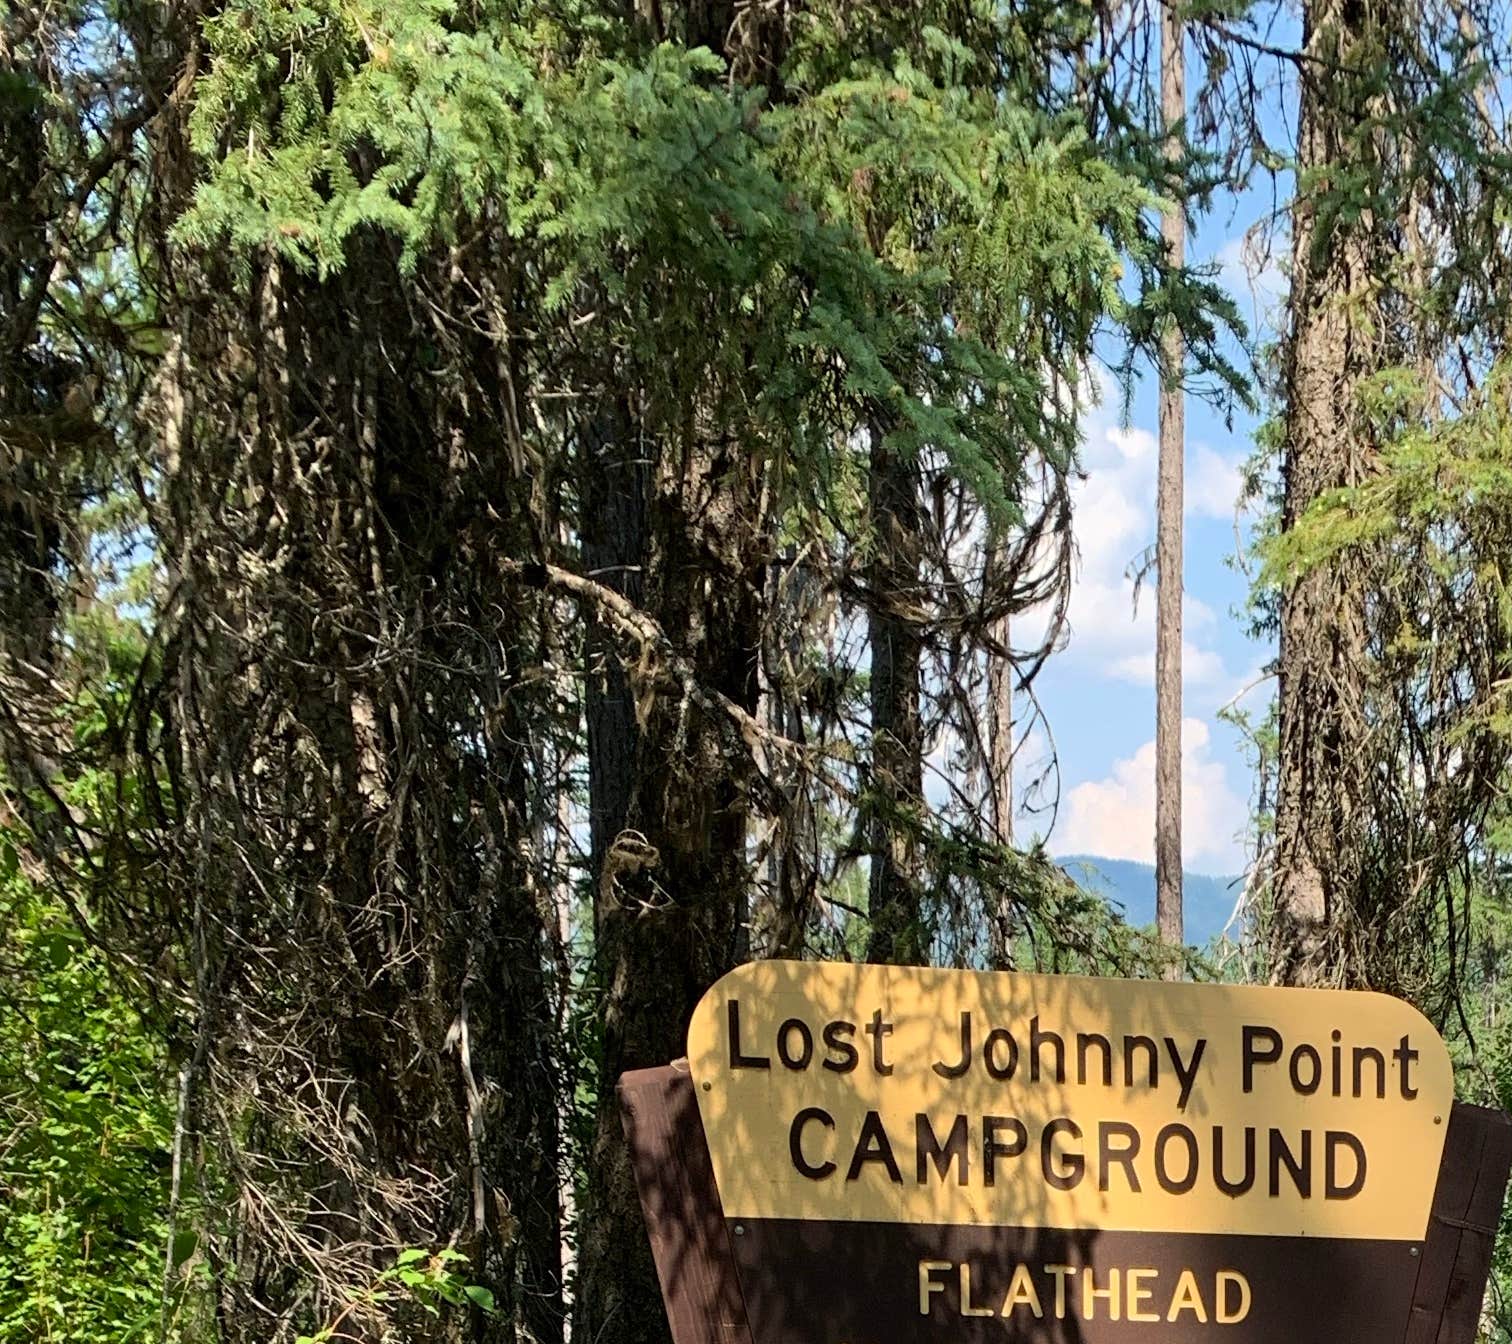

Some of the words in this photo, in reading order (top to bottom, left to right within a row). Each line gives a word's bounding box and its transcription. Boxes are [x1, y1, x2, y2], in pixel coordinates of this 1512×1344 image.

[728, 1000, 893, 1076] Lost
[932, 1011, 1207, 1110] Johnny
[1242, 1025, 1419, 1100] Point
[789, 1107, 1367, 1200] CAMPGROUND
[919, 1260, 1251, 1324] FLATHEAD
